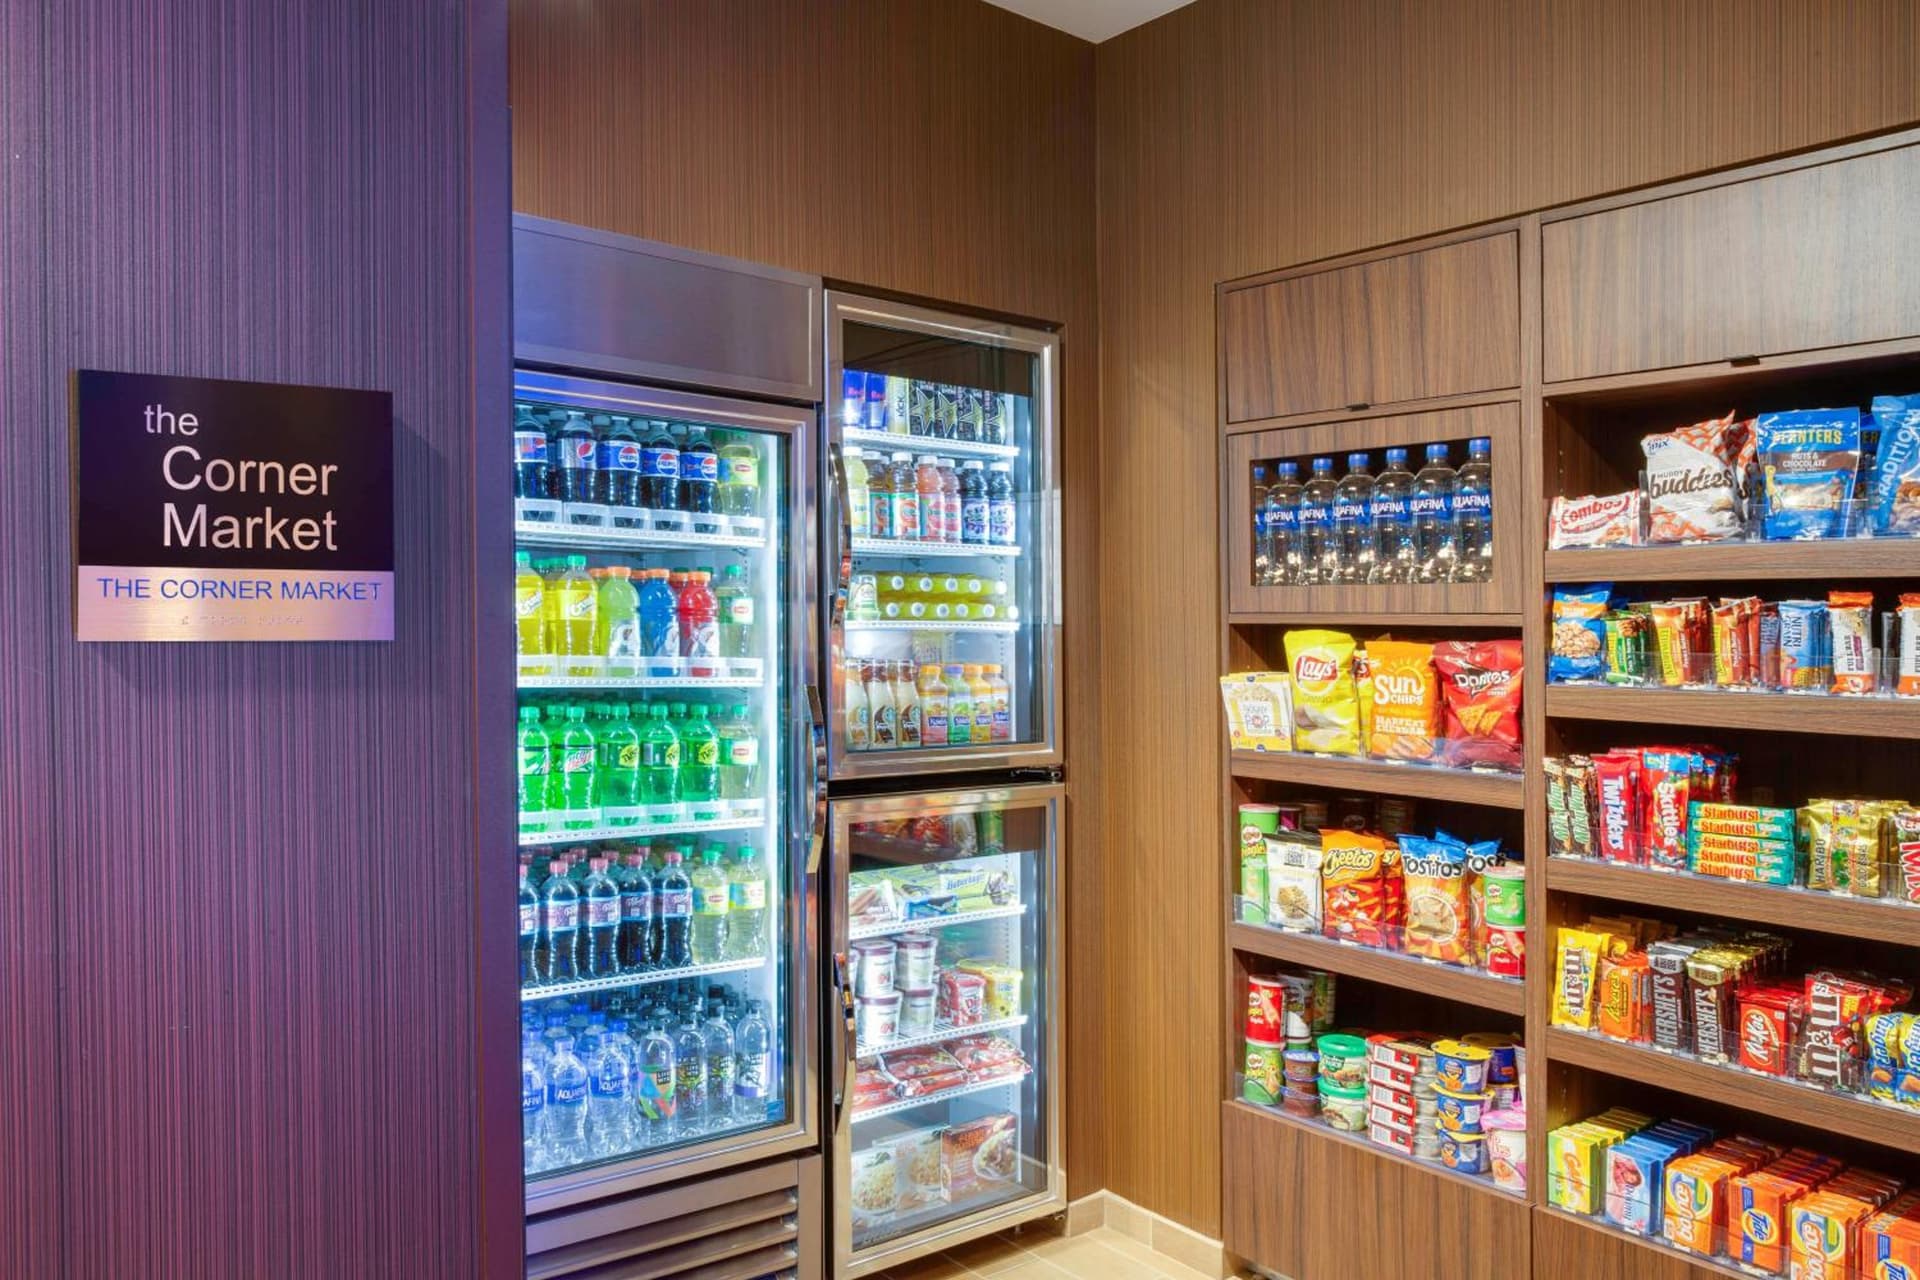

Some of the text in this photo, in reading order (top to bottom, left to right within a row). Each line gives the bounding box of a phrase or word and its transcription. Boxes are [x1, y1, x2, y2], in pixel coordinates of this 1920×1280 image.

[144, 404, 199, 436] the
[1773, 429, 1842, 445] PLANTERS
[162, 445, 338, 496] Corner
[1650, 467, 1733, 499] buddies
[163, 502, 338, 551] Market
[1561, 500, 1622, 525] Combos
[97, 578, 382, 600] THE CORNER MARKET
[1300, 656, 1336, 681] Lay's
[1375, 674, 1425, 705] Sun
[1657, 781, 1681, 847] Skittles
[1701, 820, 1756, 835] Starburst
[1703, 806, 1759, 822] Starburst
[1701, 851, 1757, 867] Starburst
[1703, 836, 1759, 853] Starburst
[1323, 848, 1376, 877] Cheetos
[1700, 863, 1756, 879] Starburst
[1815, 839, 1825, 882] HARIBO
[1654, 975, 1678, 1046] HERSHEY'S
[1694, 988, 1719, 1057] HERSHEY'S
[1748, 1210, 1769, 1241] Tide
